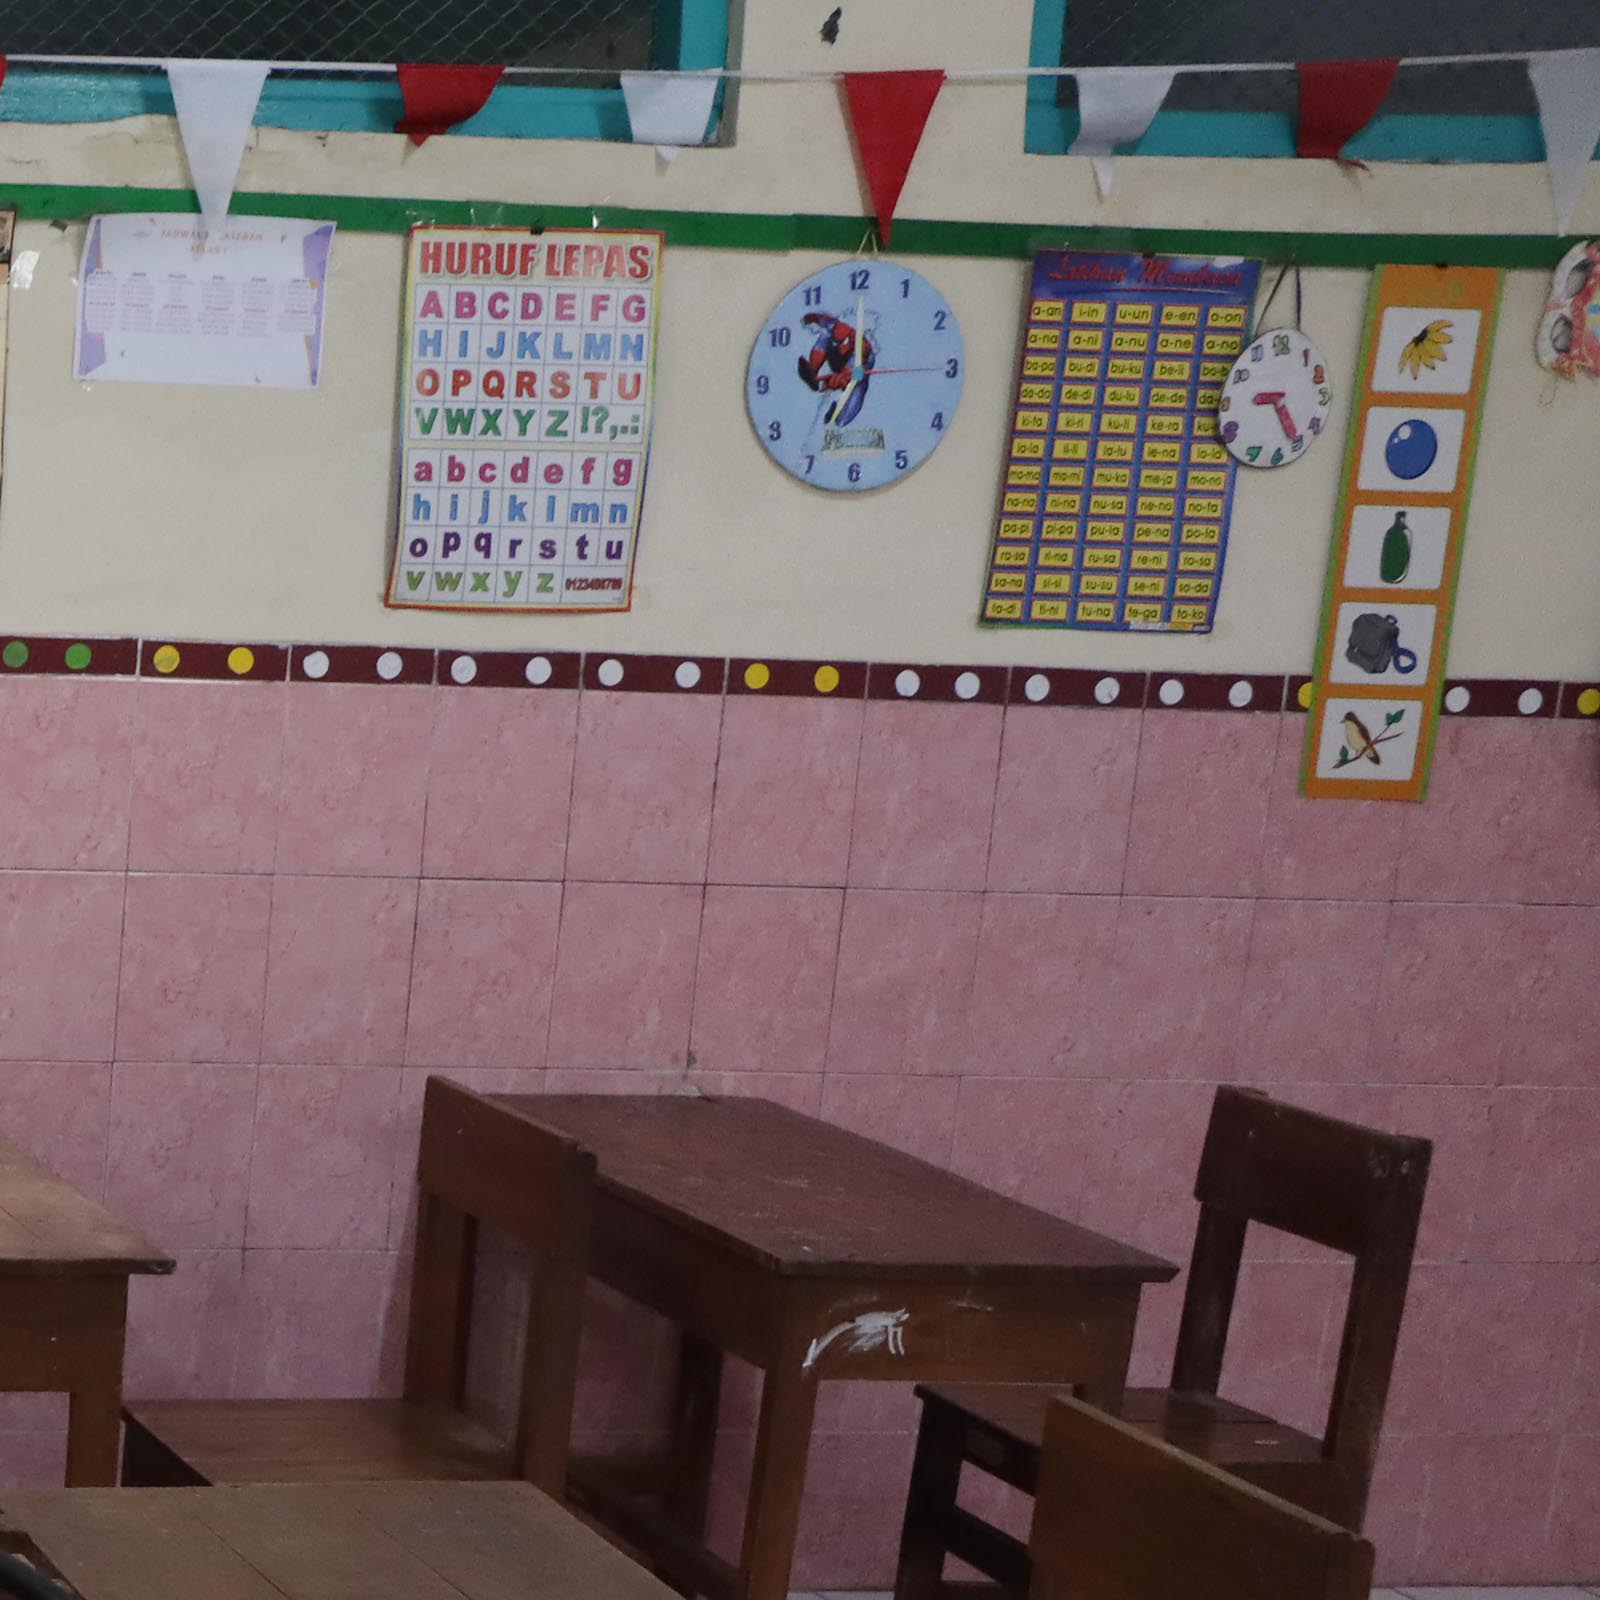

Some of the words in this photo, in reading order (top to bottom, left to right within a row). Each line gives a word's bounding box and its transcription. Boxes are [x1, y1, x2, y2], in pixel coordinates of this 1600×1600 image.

[421, 241, 537, 275] HURUF
[545, 244, 649, 279] LEPAS
[850, 270, 870, 290] 12
[901, 279, 910, 298] 1
[420, 290, 443, 318] A
[455, 292, 476, 318] B
[488, 292, 509, 319] C
[521, 293, 542, 320] D
[555, 294, 576, 320] E
[591, 295, 610, 321] F
[623, 295, 646, 322] G
[803, 286, 821, 306] 11
[934, 311, 946, 330] 2
[1033, 306, 1061, 316] a-an
[1079, 305, 1098, 316] i-in
[1119, 308, 1149, 319] u-un
[1165, 311, 1195, 321] e-en
[1211, 312, 1242, 323] o-on
[419, 330, 442, 357] H
[459, 331, 468, 357] I
[487, 331, 505, 358] J
[517, 332, 542, 359] K
[554, 333, 572, 359] L
[584, 333, 611, 360] M
[621, 334, 643, 361] N
[769, 328, 791, 347] 10
[1029, 333, 1058, 344] a-na
[1073, 333, 1097, 345] a-ni
[1115, 336, 1145, 347] a-nu
[1161, 338, 1191, 348] a-ne
[1206, 340, 1238, 350] a-no
[946, 359, 958, 378] 3
[417, 369, 439, 396] O
[452, 370, 471, 396] P
[483, 370, 505, 399] Q
[516, 371, 537, 397] R
[550, 371, 570, 398] S
[584, 372, 607, 399] T
[618, 373, 641, 400] U
[756, 375, 769, 395] 9
[415, 408, 438, 434] V
[445, 408, 475, 435] W
[479, 409, 502, 436] X
[514, 409, 535, 436] Y
[546, 411, 569, 437] Z
[931, 412, 943, 431] 4
[805, 455, 815, 473] 7
[896, 450, 907, 469] 5
[414, 461, 433, 482] a
[447, 456, 465, 482] b
[479, 463, 496, 483] c
[511, 457, 529, 483] d
[544, 464, 563, 483] e
[581, 457, 596, 484] f
[613, 458, 632, 486] g
[848, 464, 860, 482] 6
[413, 493, 430, 520] h
[450, 494, 458, 520] i
[479, 490, 489, 523] j
[508, 495, 526, 522] k
[570, 503, 599, 523] m
[609, 503, 627, 523] n
[410, 538, 427, 557] o
[442, 532, 460, 558] p
[475, 532, 491, 558] q
[509, 539, 522, 558] r
[539, 540, 556, 559] s
[576, 534, 588, 560] t
[606, 540, 623, 560] u
[406, 571, 425, 590] v
[435, 572, 463, 591] w
[470, 572, 490, 592] x
[503, 571, 523, 598] y
[537, 573, 554, 593] z
